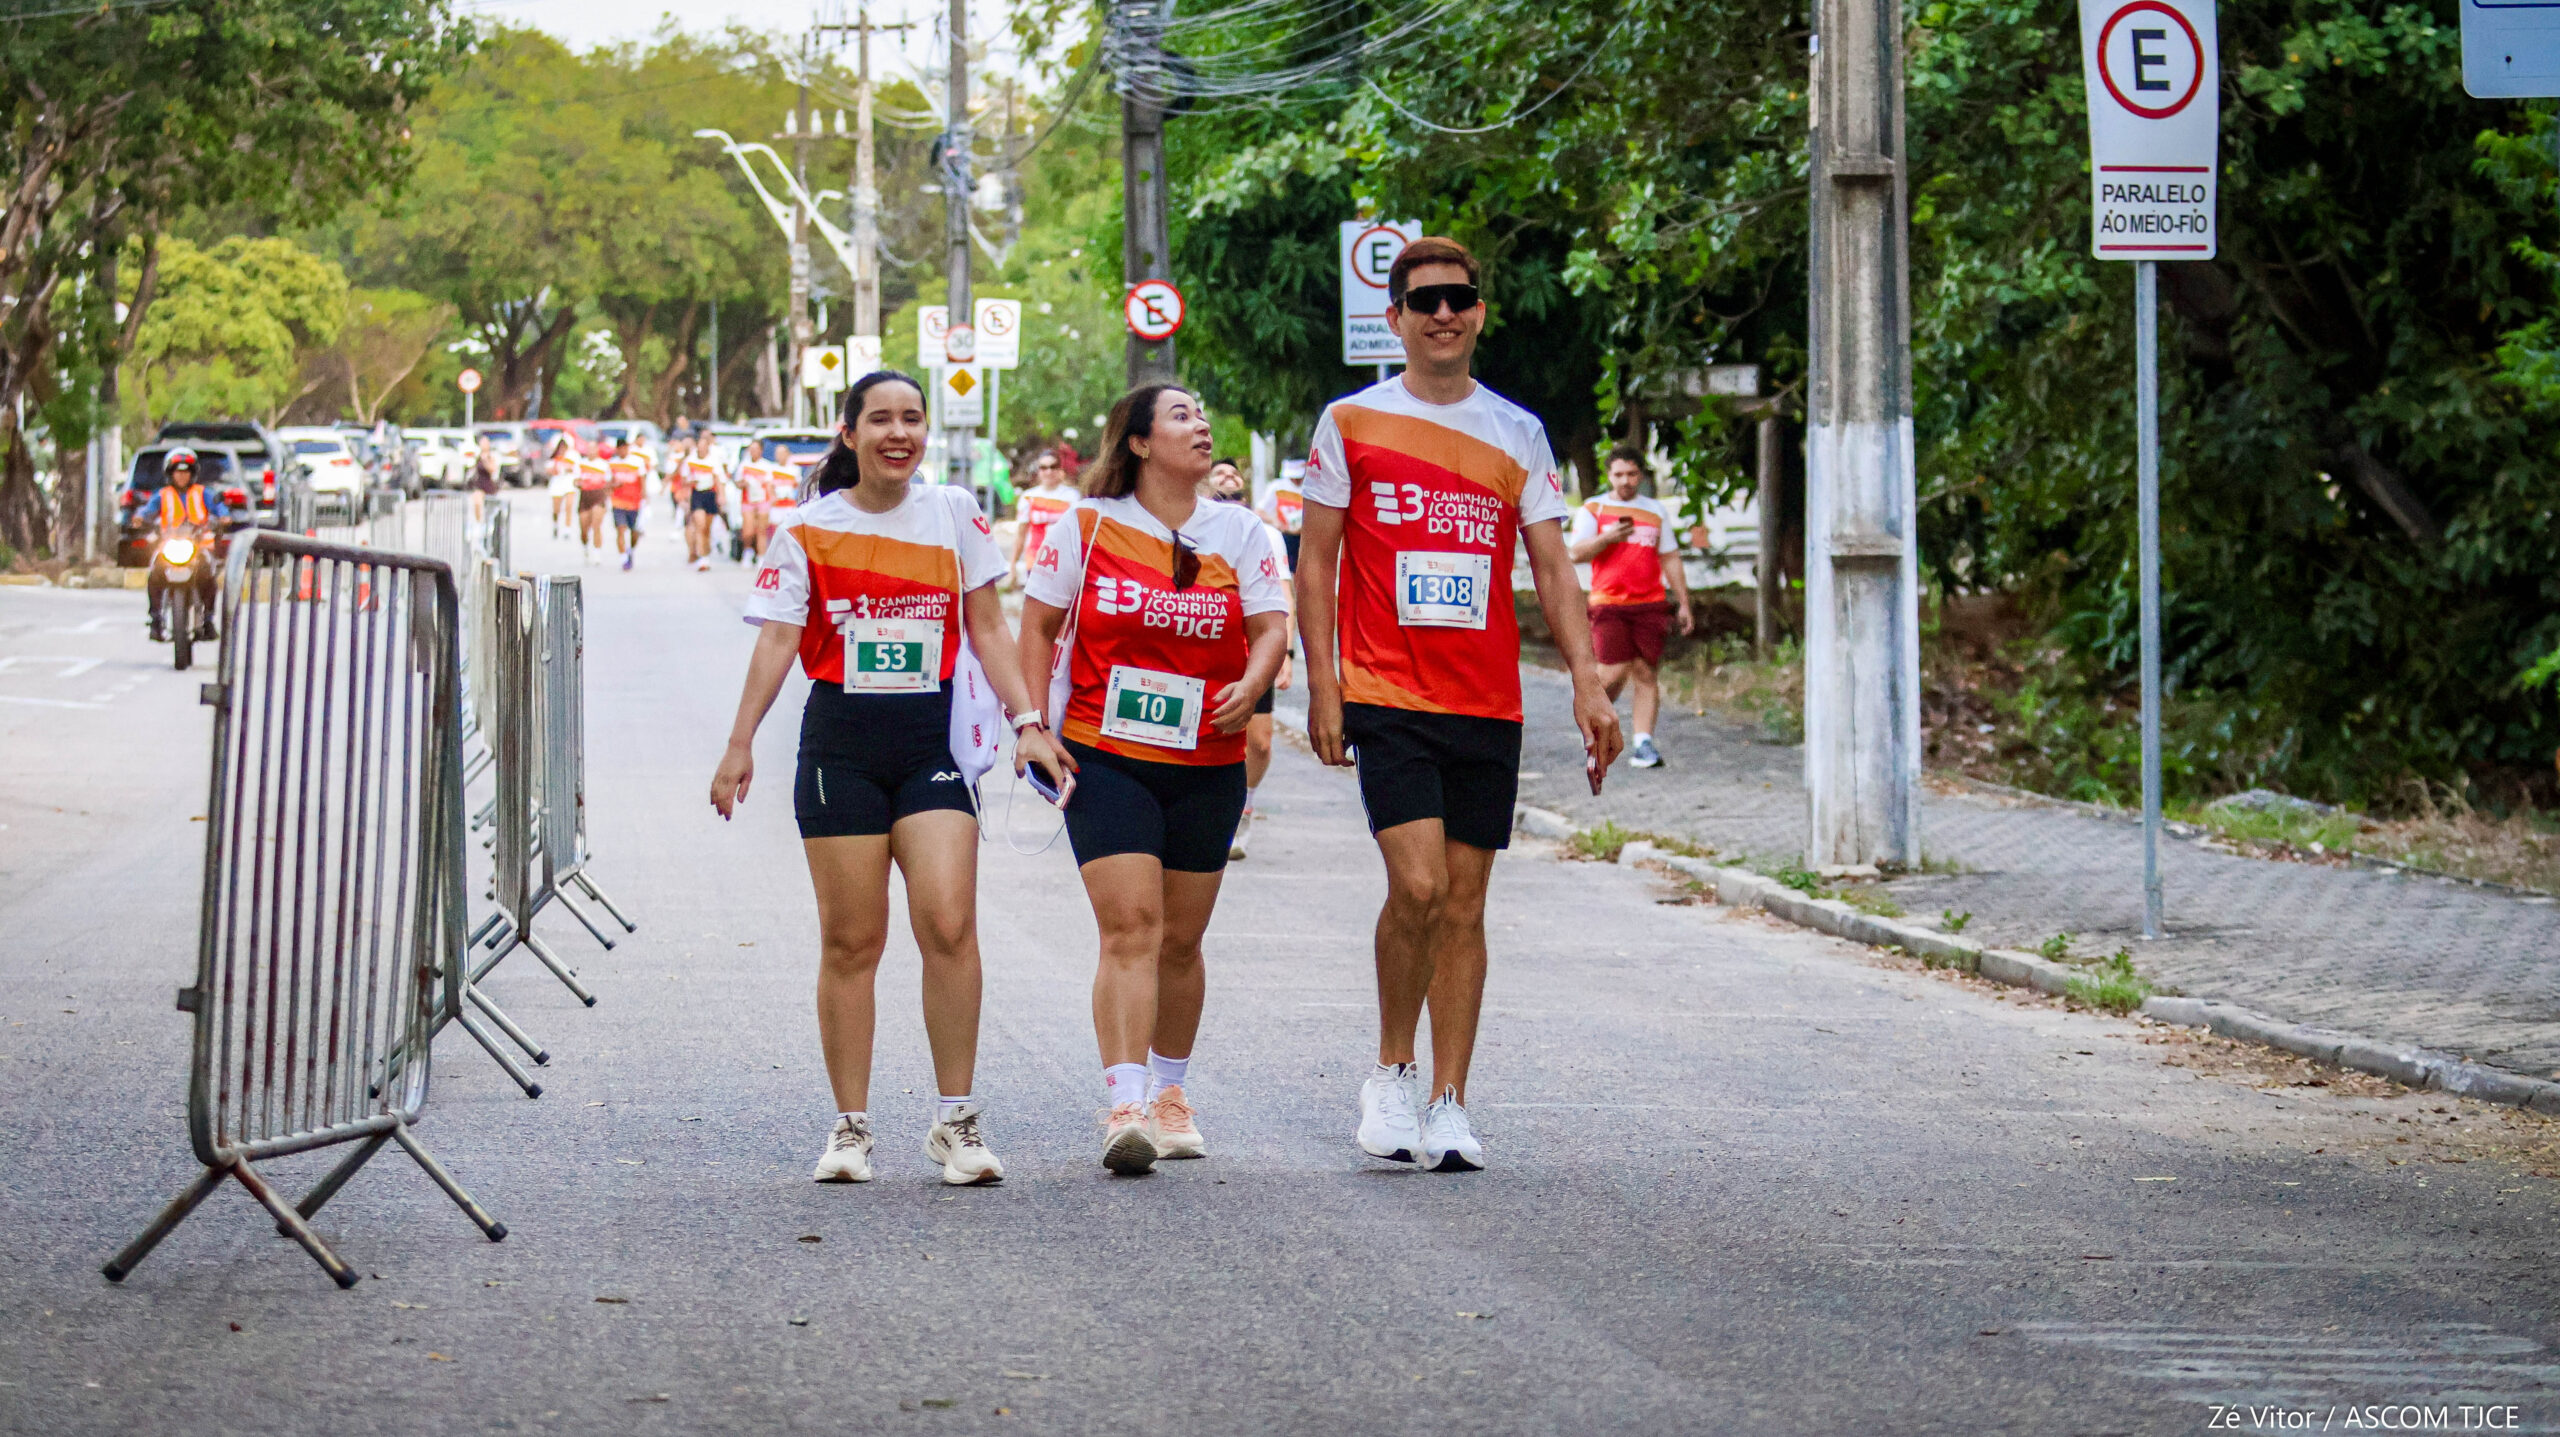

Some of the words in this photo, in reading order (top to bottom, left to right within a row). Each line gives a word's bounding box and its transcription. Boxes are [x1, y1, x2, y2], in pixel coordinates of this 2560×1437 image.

[2131, 28, 2171, 91] E
[2102, 184, 2206, 203] PARALELO
[2100, 214, 2127, 233] AO
[2130, 214, 2207, 233] MEIO-FIO
[1371, 241, 1392, 274] E
[1350, 323, 1390, 334] PARAL
[1369, 339, 1402, 350] MEIO-
[1433, 490, 1503, 509] CAMINHADA
[1428, 517, 1453, 534] DO
[1455, 519, 1497, 548] TJCE
[879, 592, 951, 607] CAMINHADA
[1152, 589, 1228, 603] CAMINHADA
[1411, 576, 1471, 604] 1308
[1144, 611, 1171, 628] DO
[1173, 615, 1225, 639] TJCE
[875, 643, 907, 671] 53
[1137, 694, 1167, 722] 10
